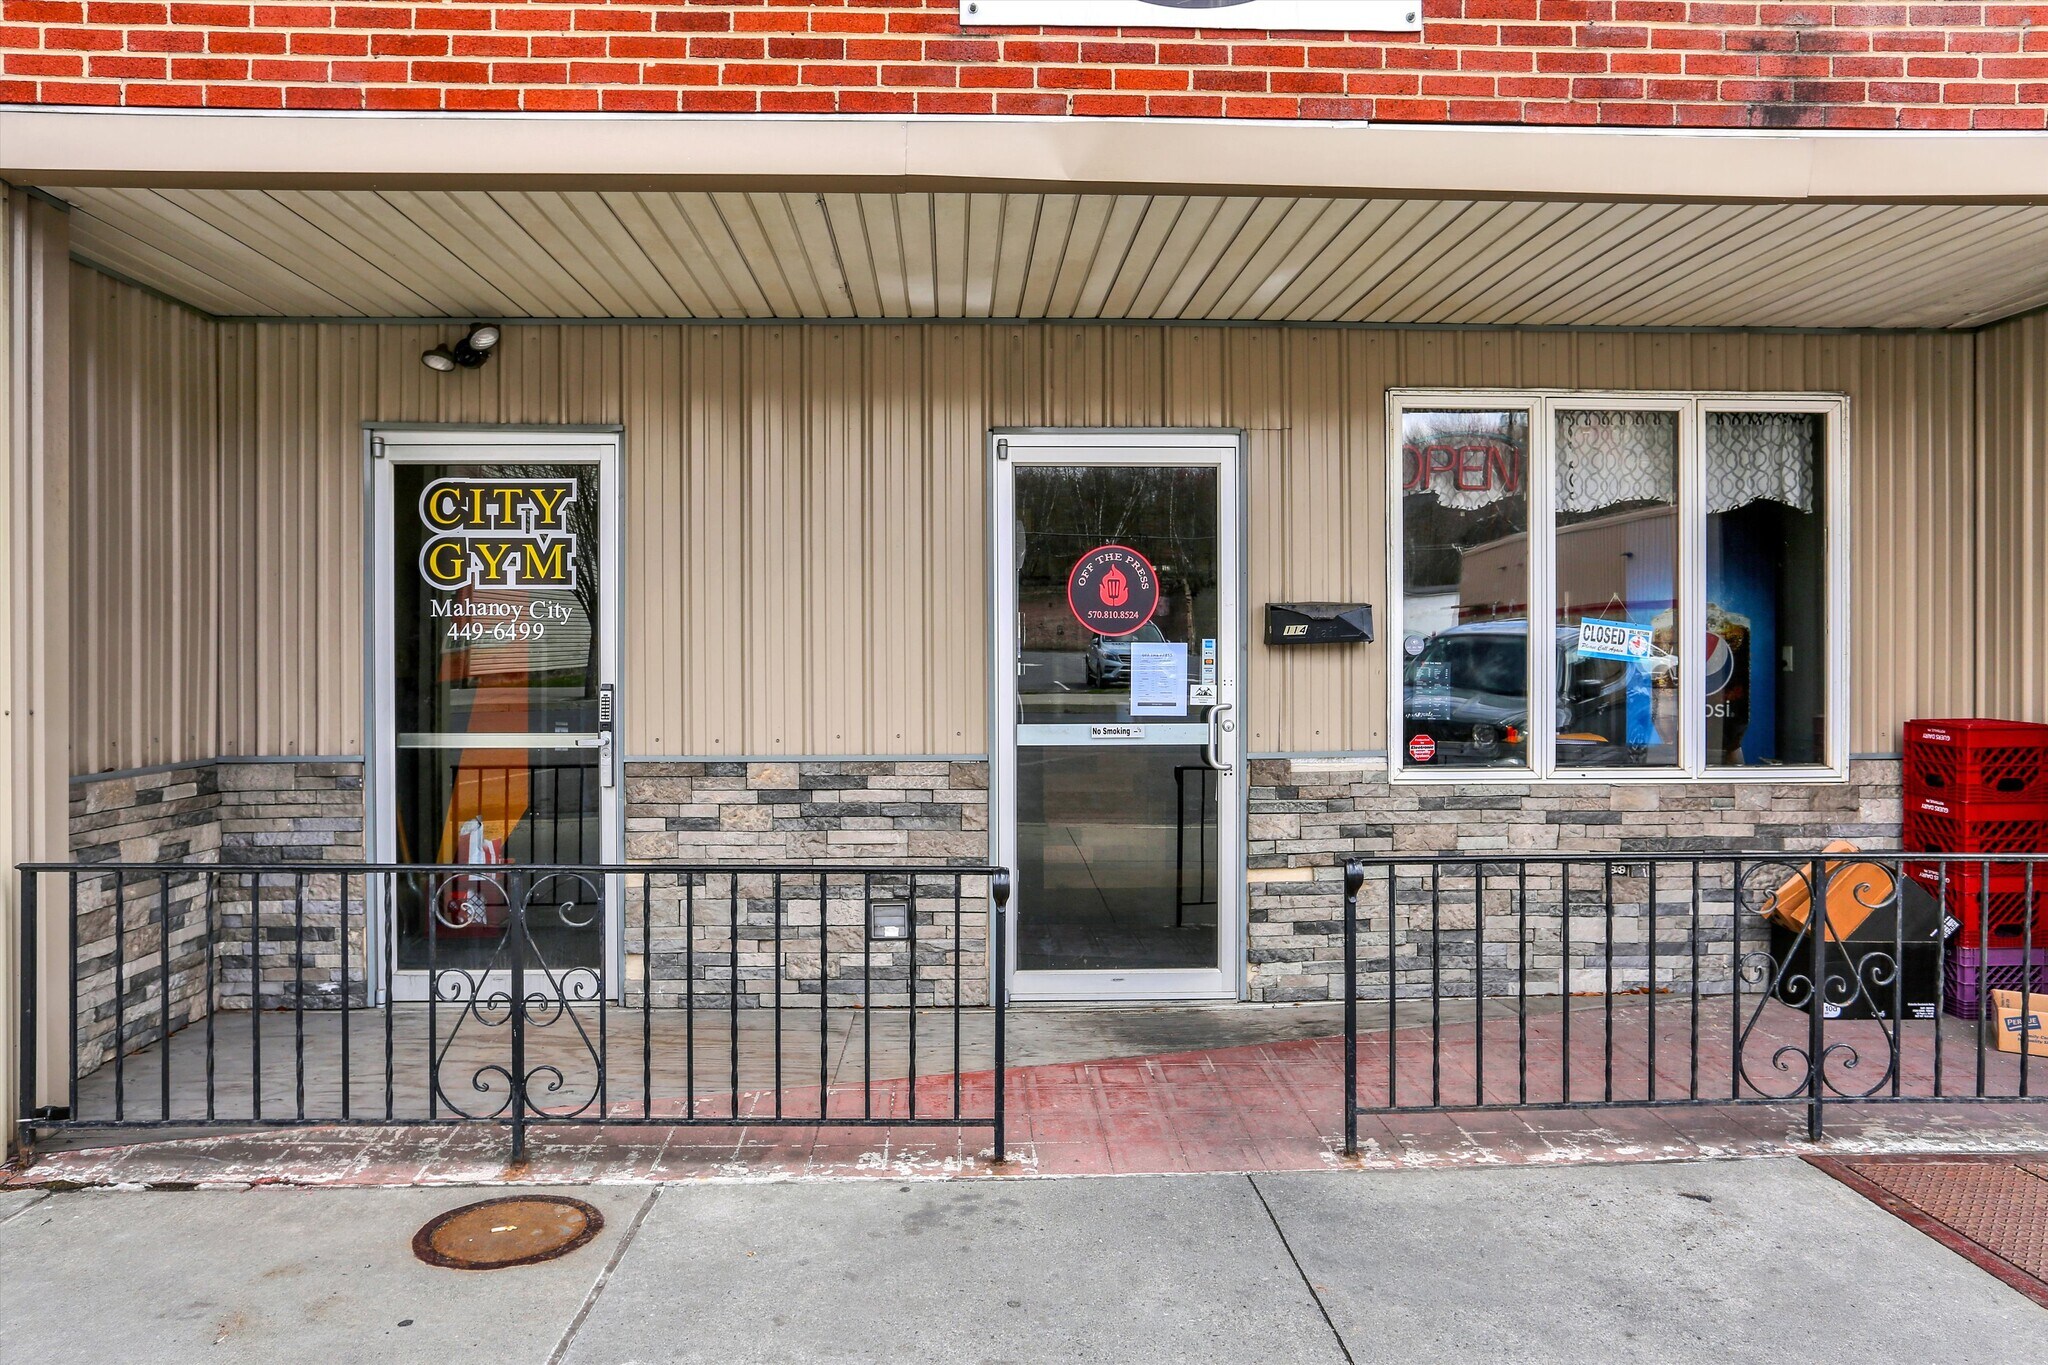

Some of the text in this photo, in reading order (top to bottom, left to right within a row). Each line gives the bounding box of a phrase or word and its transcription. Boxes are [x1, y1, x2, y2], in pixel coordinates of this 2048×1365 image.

[1402, 444, 1519, 492] OPEN
[428, 486, 567, 526] CITY
[428, 542, 567, 581] GYM
[1078, 552, 1149, 590] OFF THE PRESS
[430, 598, 573, 625] Mahanoy City
[1087, 610, 1139, 619] 570.810.8524
[447, 622, 545, 641] 449-6499
[1286, 626, 1306, 634] 114
[1583, 624, 1626, 646] CLOSED
[1092, 726, 1131, 736] No Smoking
